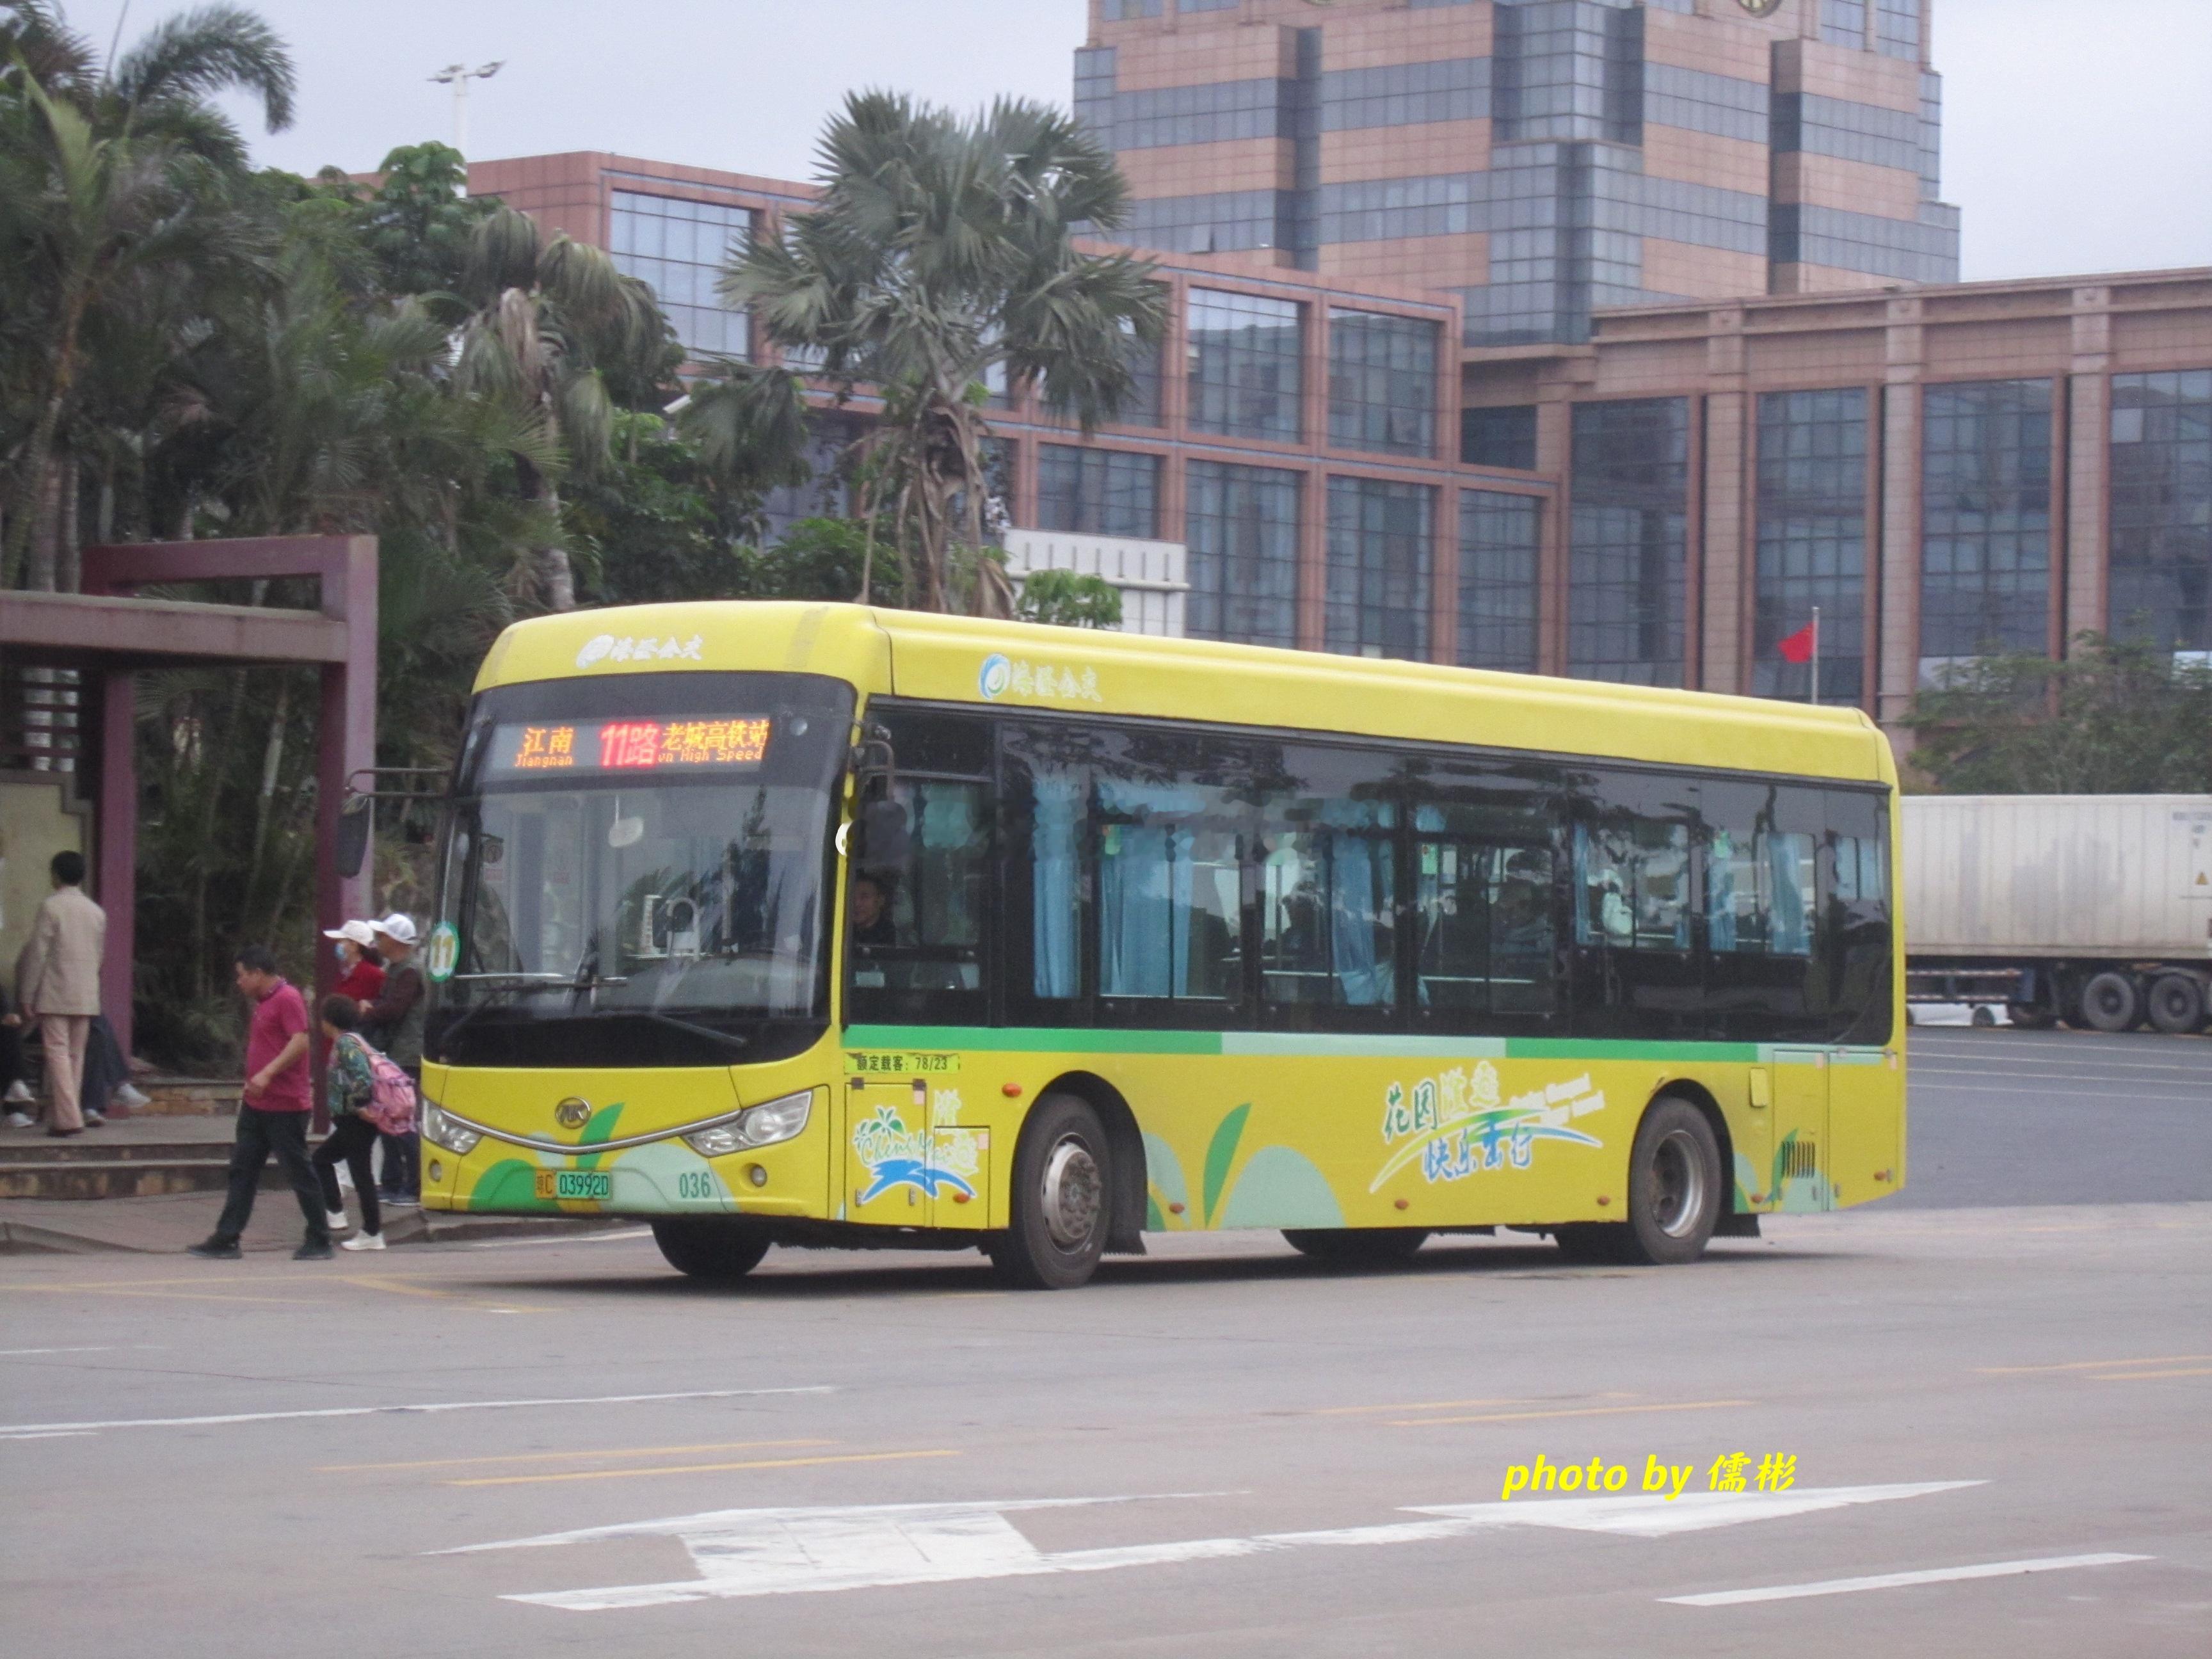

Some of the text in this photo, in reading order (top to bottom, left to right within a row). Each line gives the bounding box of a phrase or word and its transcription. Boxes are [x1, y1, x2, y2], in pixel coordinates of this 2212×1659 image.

[523, 726, 575, 757] 江南
[600, 723, 660, 767] 11路
[660, 719, 769, 750] 老城高铁站
[515, 753, 574, 768] Jiangnan
[680, 747, 710, 762] High
[716, 746, 764, 762] Speed
[433, 935, 454, 969] 11
[915, 1057, 948, 1071] 78/23
[678, 1171, 712, 1199] 036
